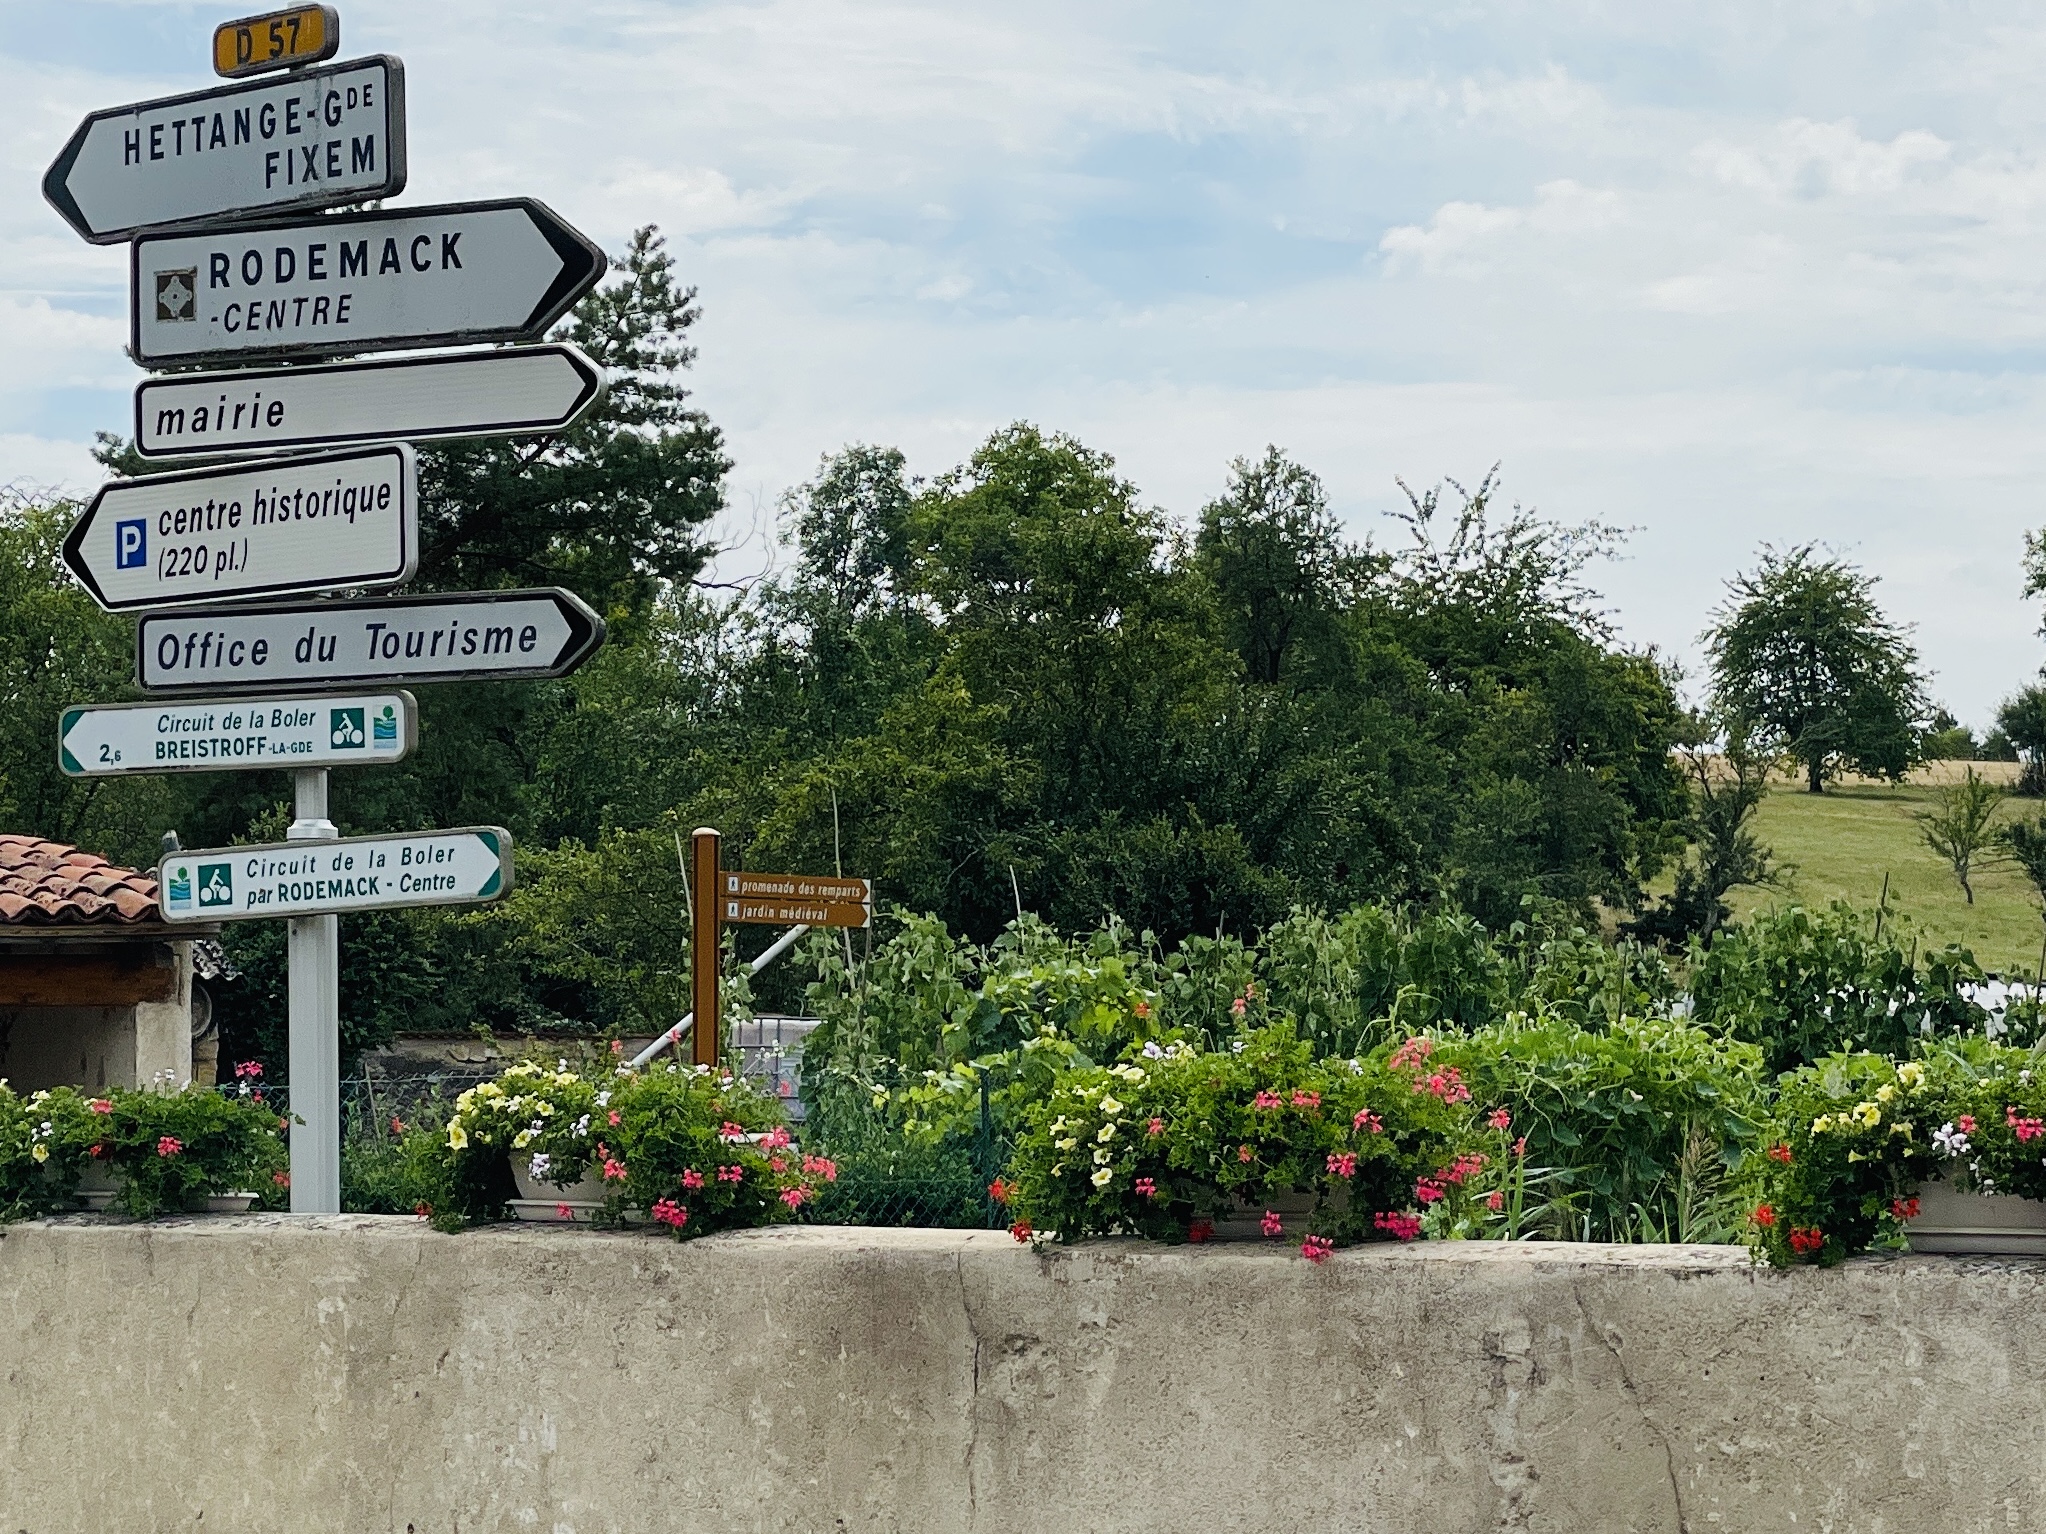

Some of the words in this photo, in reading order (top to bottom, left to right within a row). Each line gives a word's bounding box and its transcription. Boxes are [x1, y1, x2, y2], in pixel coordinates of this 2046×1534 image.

[236, 28, 253, 66] D
[268, 19, 301, 57] 57
[265, 135, 375, 190] FIXEM
[209, 232, 463, 289] RODEMACK
[211, 294, 353, 333] -CENTRE
[155, 392, 285, 436] mairie
[158, 496, 242, 537] centre
[252, 478, 392, 525] historique
[121, 524, 142, 566] P
[157, 549, 209, 582] (220
[214, 537, 249, 580] pl.)
[157, 632, 269, 670] Office
[295, 626, 337, 664] du
[366, 621, 537, 662] Tourisme
[157, 713, 214, 734] Circuit
[222, 712, 243, 731] de
[249, 710, 264, 729] la
[271, 708, 317, 727] Boler
[99, 744, 122, 764] 2,6
[155, 736, 314, 760] BREISTROFF-LA-GDE
[246, 857, 317, 879] Circuit
[332, 854, 354, 873] de
[368, 850, 387, 869] la
[400, 845, 455, 867] Boler
[246, 889, 274, 910] par
[277, 876, 380, 901] RODEMACK
[399, 873, 456, 894] Centre
[741, 881, 795, 894] promenade
[799, 882, 815, 895] des
[818, 885, 861, 899] remparts
[741, 904, 775, 920] jardin
[779, 906, 828, 921] médiéval
